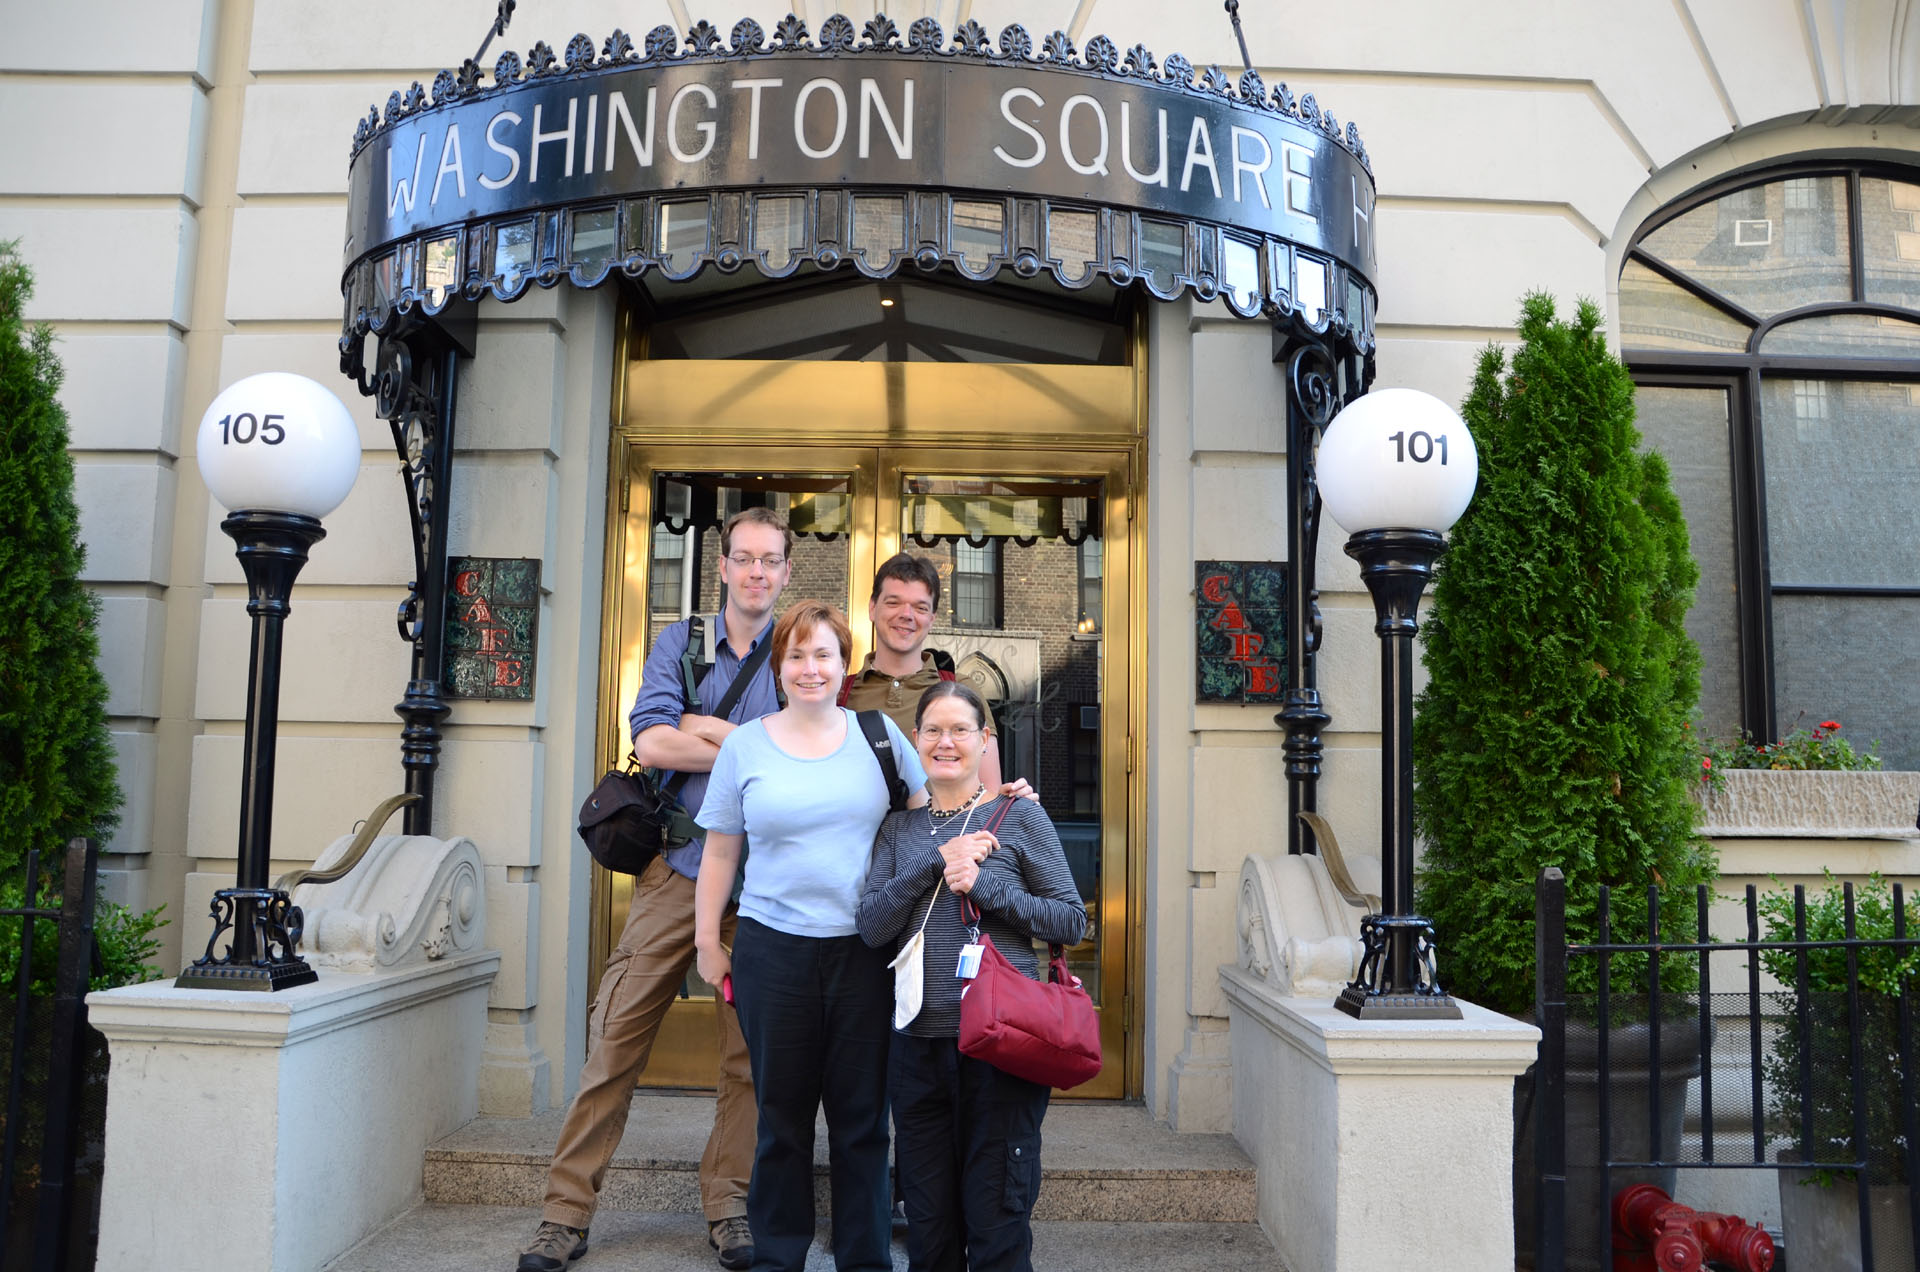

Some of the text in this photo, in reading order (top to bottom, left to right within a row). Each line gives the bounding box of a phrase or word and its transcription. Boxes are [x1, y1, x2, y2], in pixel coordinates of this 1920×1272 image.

[387, 77, 1377, 273] WASHINGTON SQUARE H
[218, 412, 286, 446] 105
[1388, 430, 1448, 466] 101
